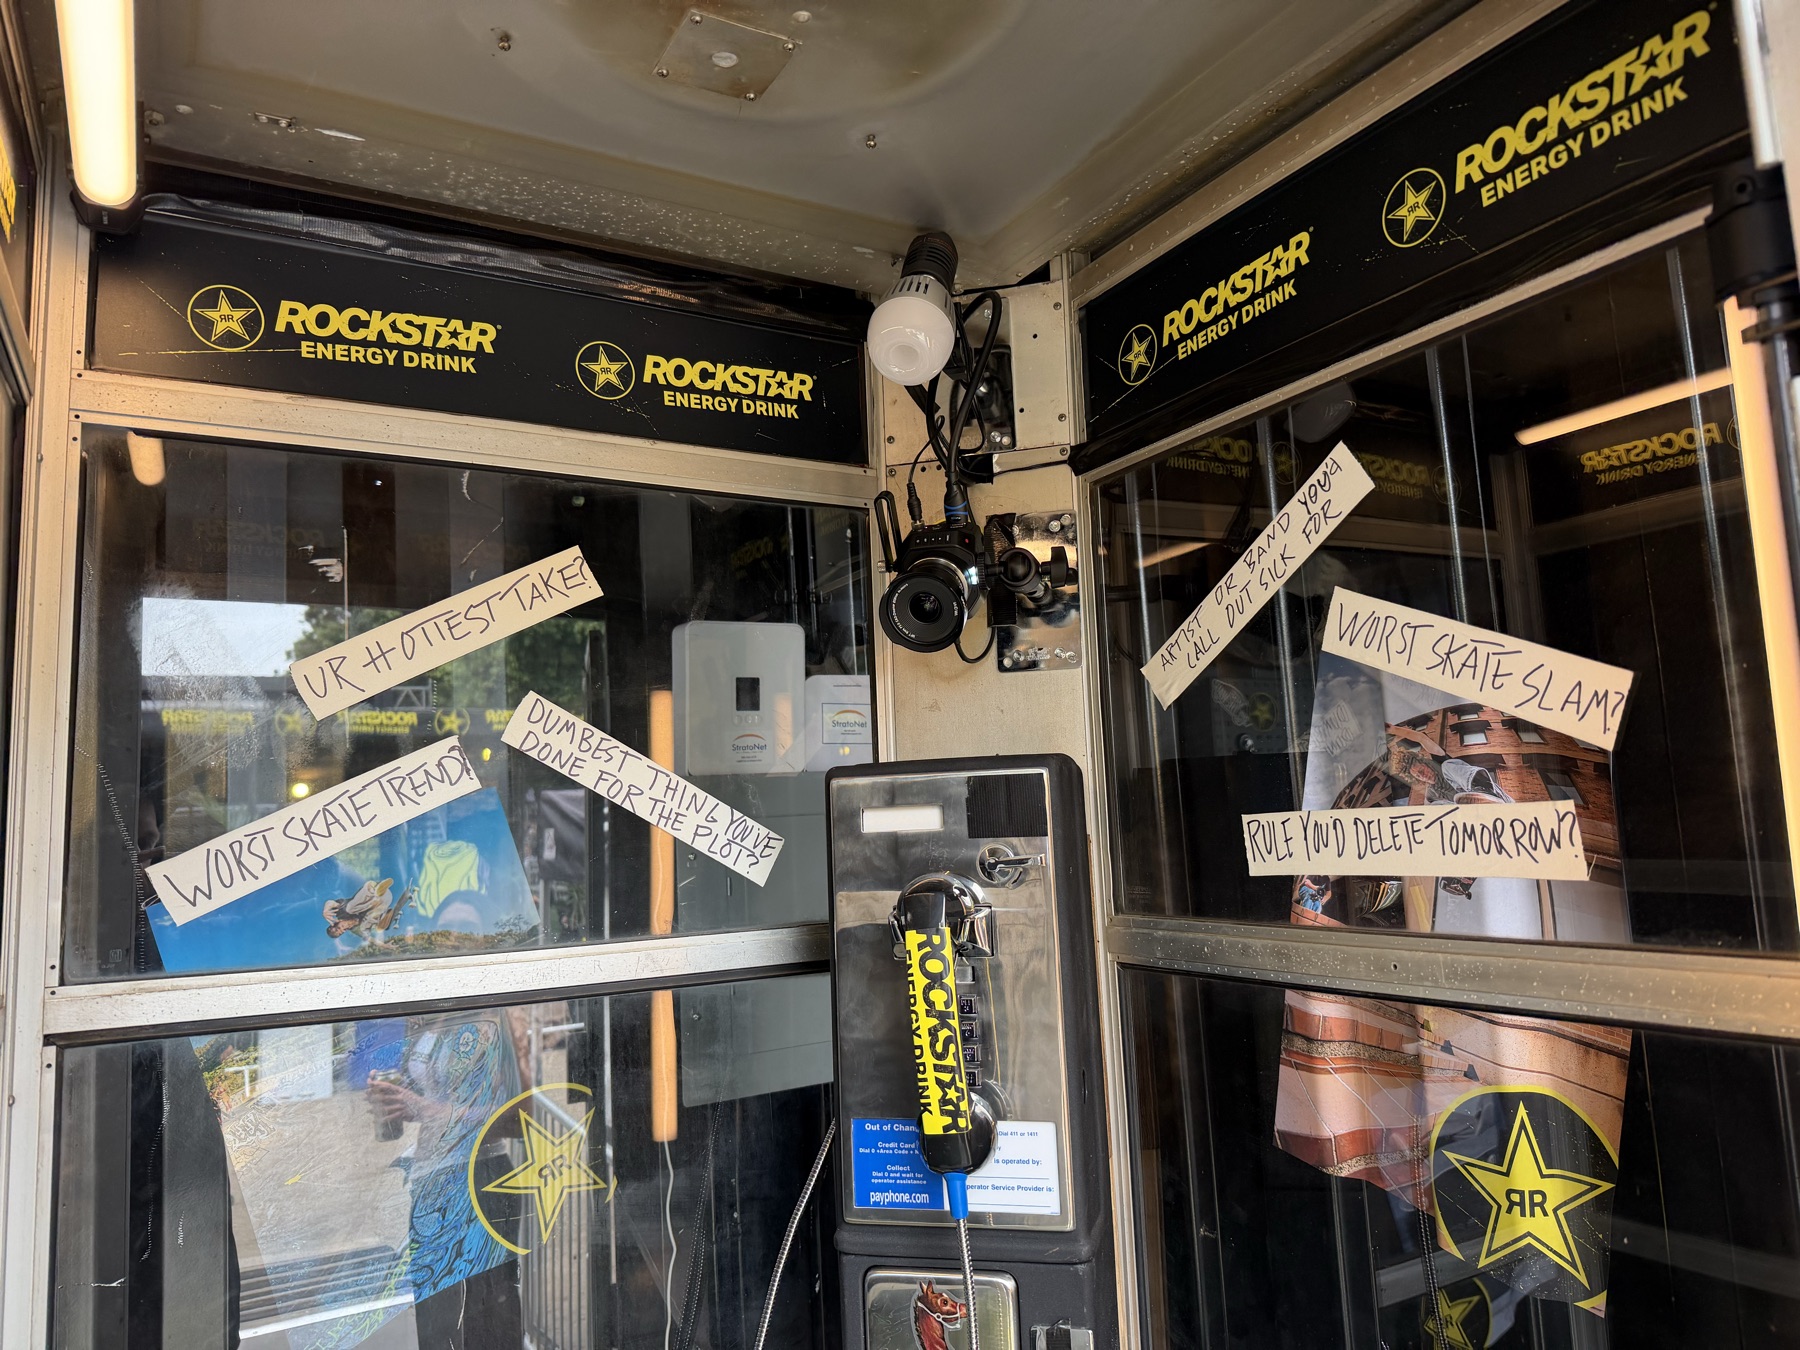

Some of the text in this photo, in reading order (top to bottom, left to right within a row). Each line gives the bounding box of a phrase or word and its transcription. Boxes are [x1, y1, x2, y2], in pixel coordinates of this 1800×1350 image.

[1454, 9, 1713, 194] ROCKSTAR
[1479, 76, 1689, 208] ENERGY DRINK
[1161, 230, 1311, 348] ROCKSTAR
[1177, 279, 1298, 361] ENERGY DRINK
[274, 300, 496, 353] ROCKSTAR
[300, 341, 477, 374] ENERGY DRINK
[642, 354, 814, 402] ROCKSTAR
[663, 390, 800, 420] ENERGY DRINK
[1159, 605, 1203, 672] ARTIST
[1214, 572, 1238, 606] OR
[1242, 512, 1290, 574] BAND
[1226, 579, 1256, 629] OUT
[1302, 498, 1343, 545] FOR
[302, 556, 593, 699] UR HOTTEST TAKE?
[1338, 602, 1625, 735] WORST SKATE SLAM?
[731, 743, 767, 752] StratoNet
[832, 719, 867, 728] StratoNet
[527, 697, 643, 774] DUMBEST
[646, 764, 719, 825] THING
[163, 744, 475, 908] WORST SKATE TREND?
[518, 730, 760, 875] DONE FOR THE PLOT?
[1246, 817, 1294, 863] RULE
[1353, 812, 1425, 860] DELETE
[1424, 806, 1579, 864] TOMORROW?
[916, 930, 971, 1134] ROCKSTAR
[865, 1123, 880, 1131] Out
[882, 1123, 891, 1131] of
[877, 1141, 898, 1149] Credit
[869, 1190, 929, 1206] payphone.com
[1001, 1158, 1030, 1167] operated
[1031, 1158, 1042, 1168] by:
[1016, 1184, 1044, 1192] Provider
